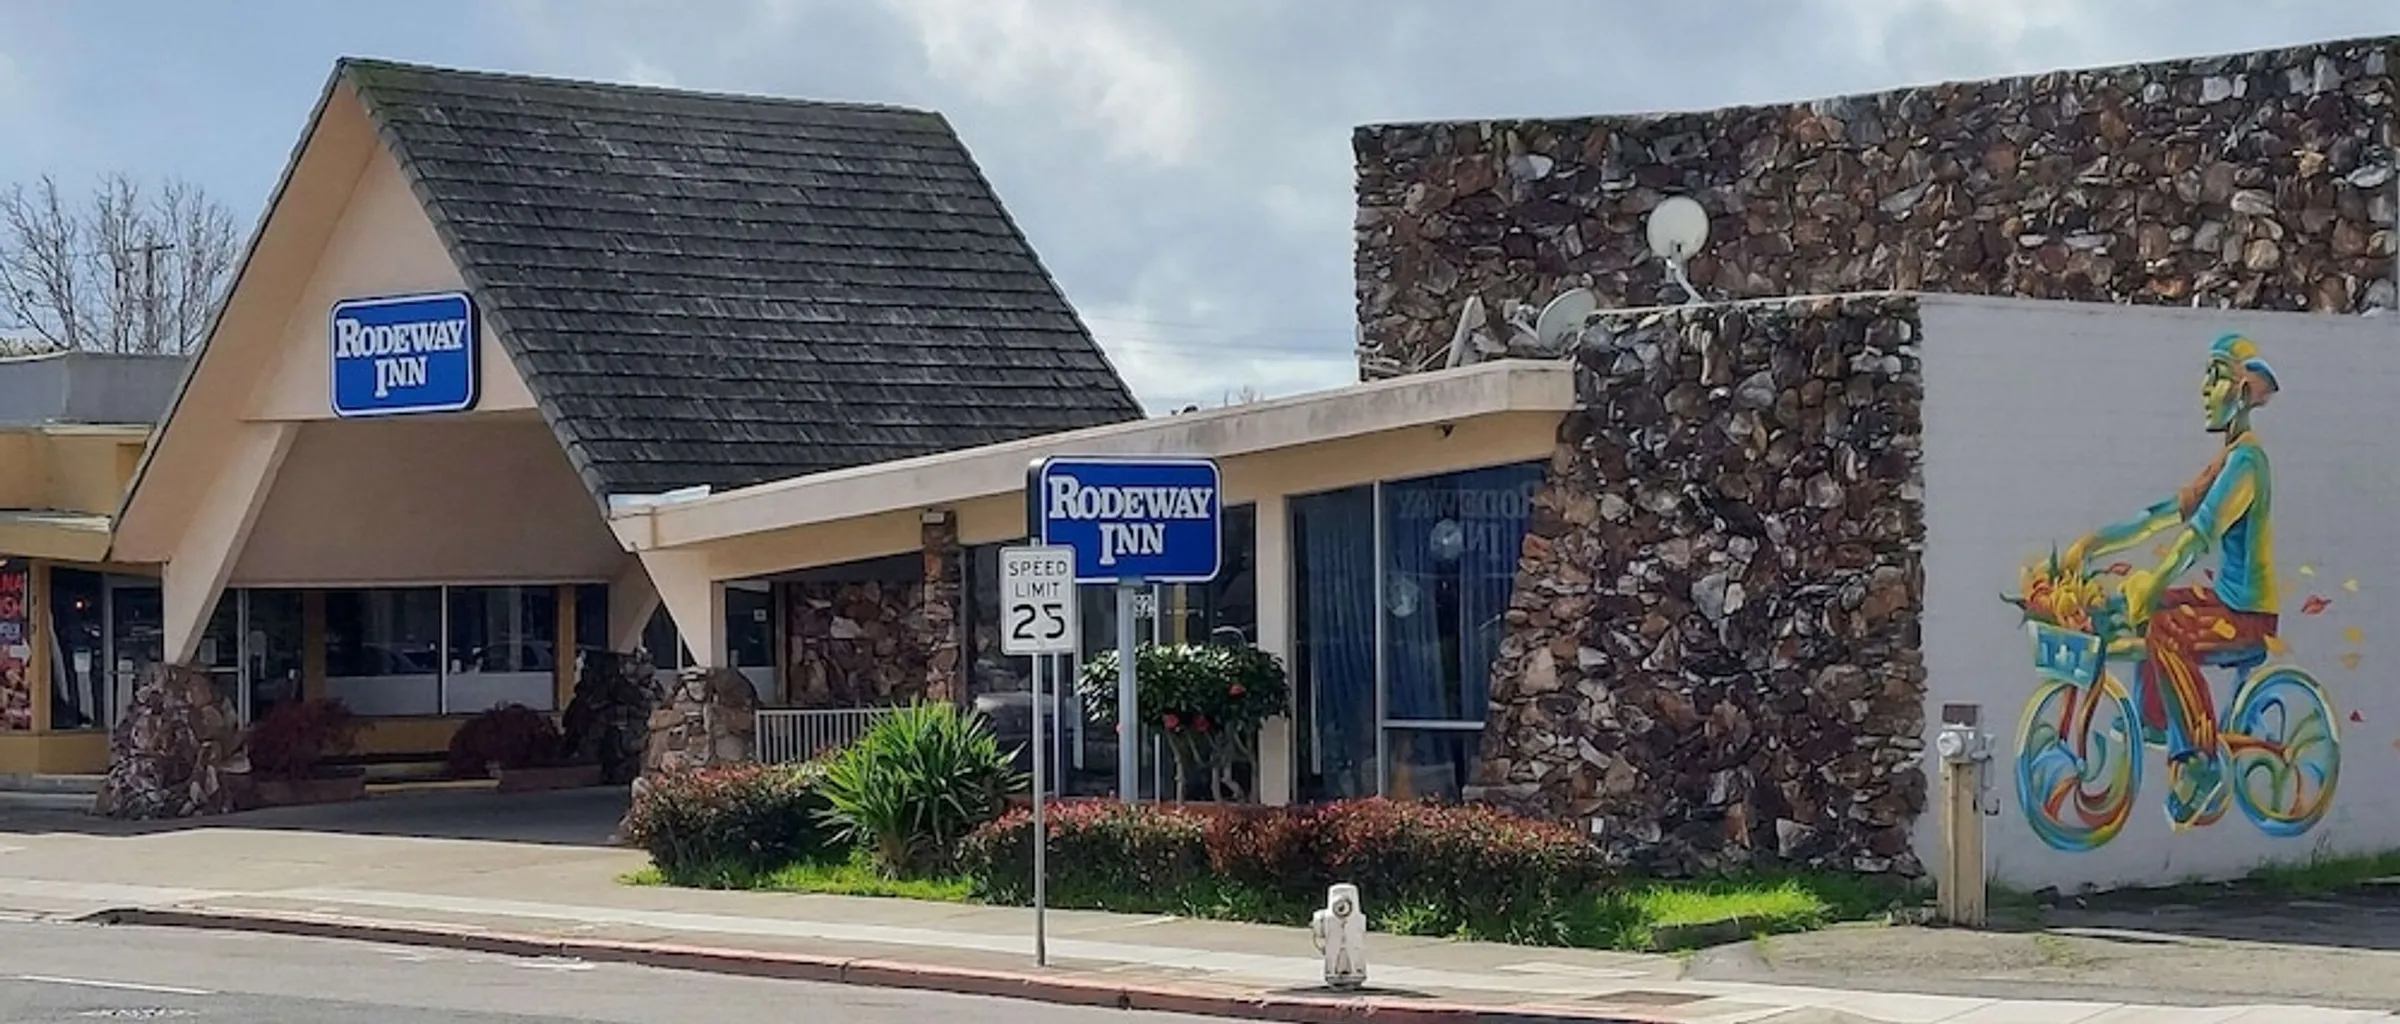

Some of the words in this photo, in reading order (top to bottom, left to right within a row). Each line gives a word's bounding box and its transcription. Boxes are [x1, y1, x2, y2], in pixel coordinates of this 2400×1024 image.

[337, 318, 465, 358] RODEWAY
[375, 356, 426, 398] INN
[1049, 475, 1213, 519] RODEWAY
[1099, 522, 1165, 566] INN
[1008, 560, 1067, 576] SPEED
[1015, 581, 1060, 598] LIMIT
[1012, 603, 1066, 639] 25
